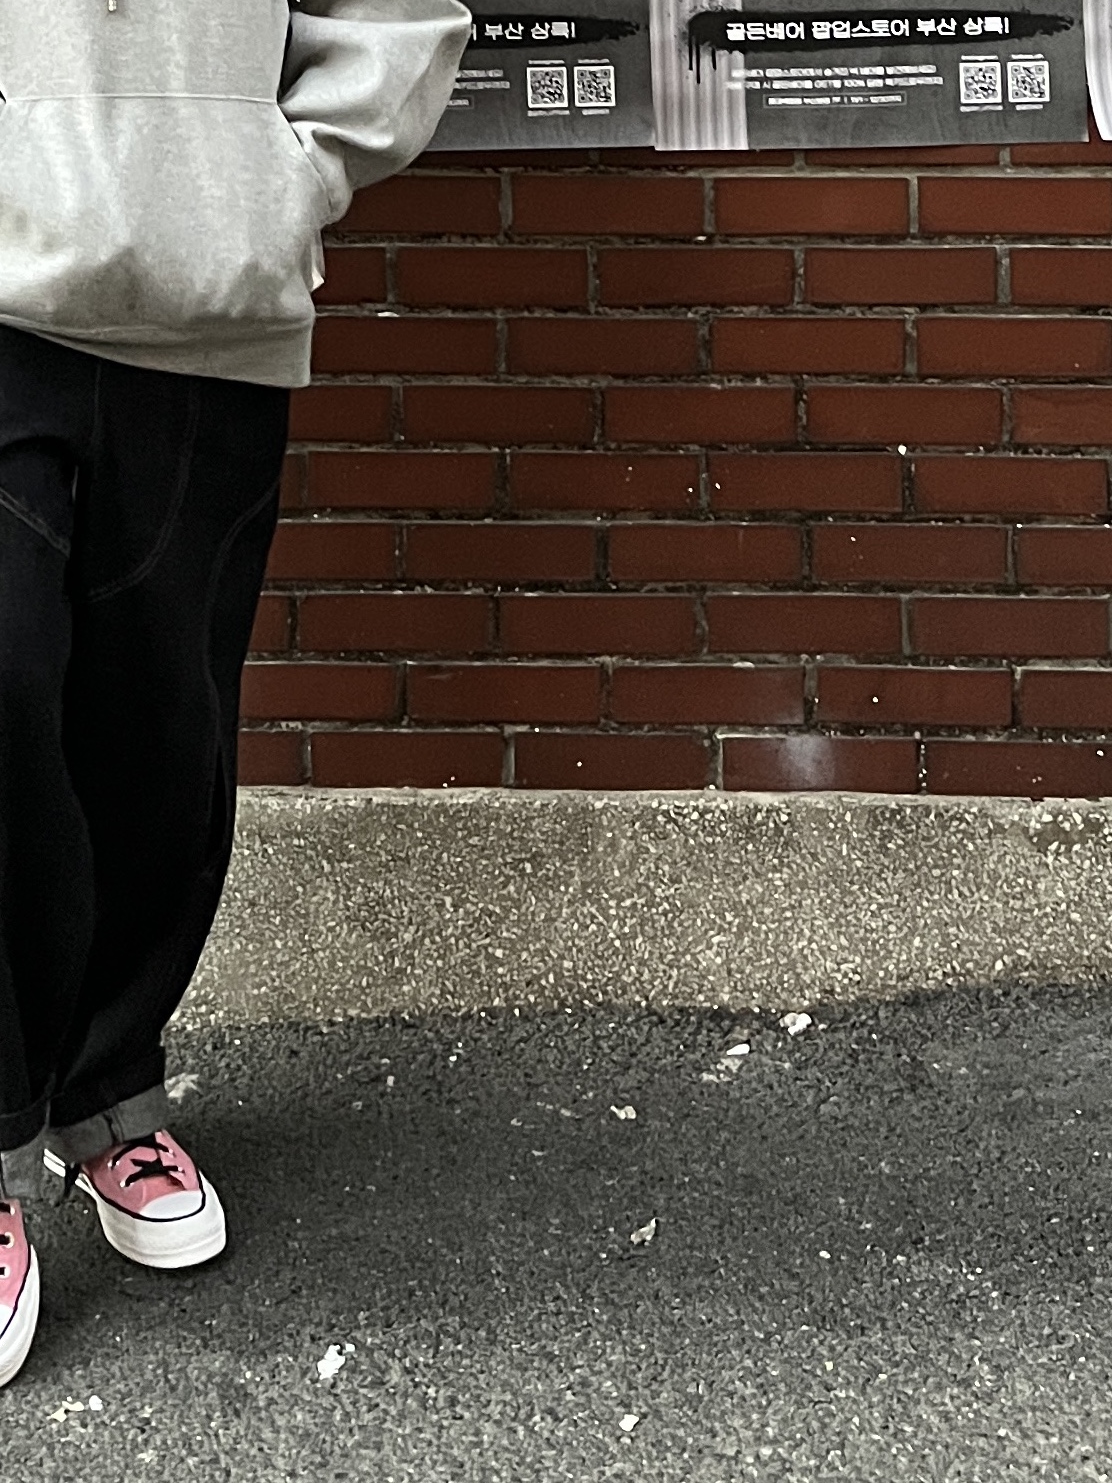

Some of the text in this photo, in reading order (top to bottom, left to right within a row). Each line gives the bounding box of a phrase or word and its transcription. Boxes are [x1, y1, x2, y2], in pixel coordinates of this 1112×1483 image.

[485, 22, 525, 41] 부산
[725, 22, 805, 41] 골든베어
[811, 19, 910, 39] 팝업스토어
[916, 18, 957, 36] 부산
